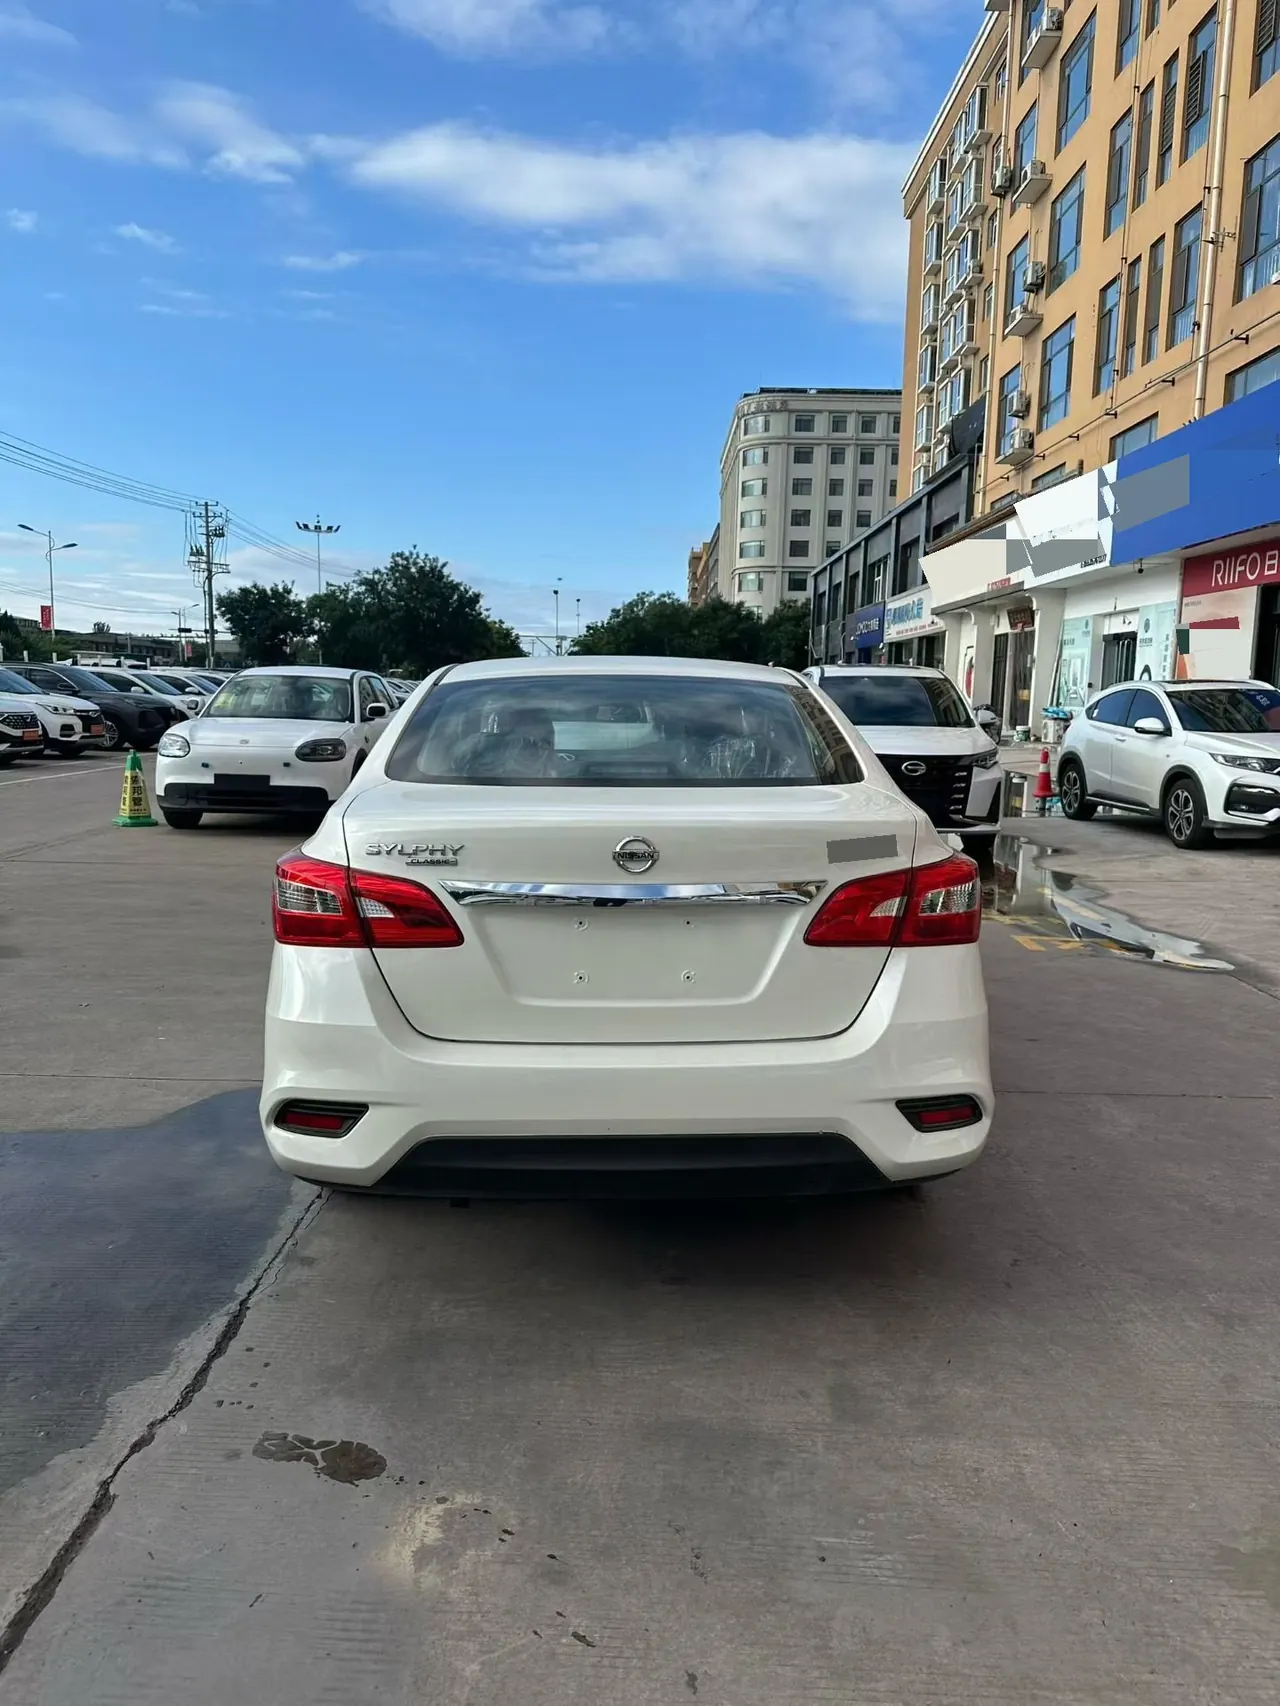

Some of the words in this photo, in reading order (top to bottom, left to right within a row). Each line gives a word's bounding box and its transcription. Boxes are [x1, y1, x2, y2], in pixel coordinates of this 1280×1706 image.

[1211, 552, 1261, 587] RIIFO
[365, 843, 465, 856] SYLPHY
[617, 851, 654, 859] NISSAN
